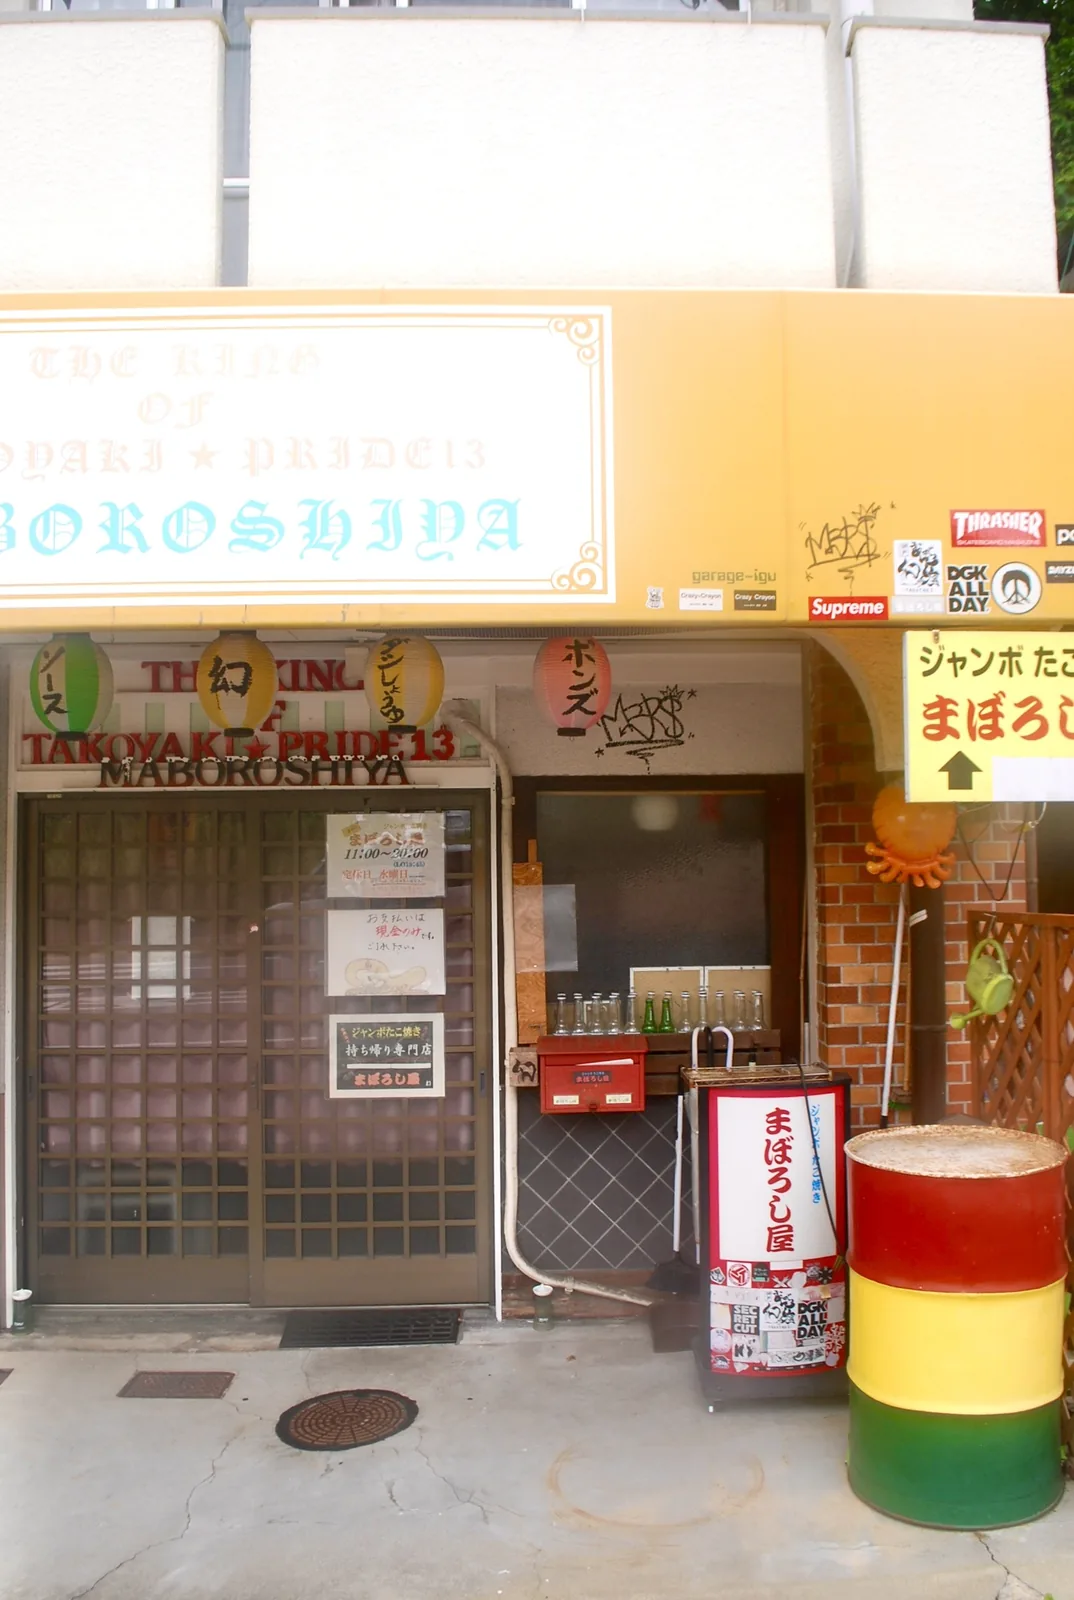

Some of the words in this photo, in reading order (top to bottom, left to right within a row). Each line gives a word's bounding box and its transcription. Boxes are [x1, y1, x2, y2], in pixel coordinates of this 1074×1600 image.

[28, 344, 139, 384] THE
[172, 342, 322, 380] KING
[137, 391, 214, 430] OF
[953, 511, 1043, 539] THRASHER
[947, 566, 988, 581] DGK
[949, 582, 989, 596] ALL
[811, 598, 884, 619] Supreme
[949, 597, 989, 612] DAY
[39, 646, 71, 715] ソース
[141, 660, 201, 693] TH
[208, 655, 254, 698] 幻
[22, 731, 237, 764] TAKOYAKI
[98, 755, 410, 788] MABOROSHIYA
[345, 1043, 432, 1057] 持ち帰り専門店
[764, 1107, 794, 1252] まぼろし屋
[733, 1305, 758, 1315] SEC
[797, 1300, 827, 1314] DGK
[734, 1315, 756, 1324] RET
[798, 1314, 827, 1327] ALL
[733, 1324, 756, 1334] CUT
[797, 1325, 826, 1339] DAY
